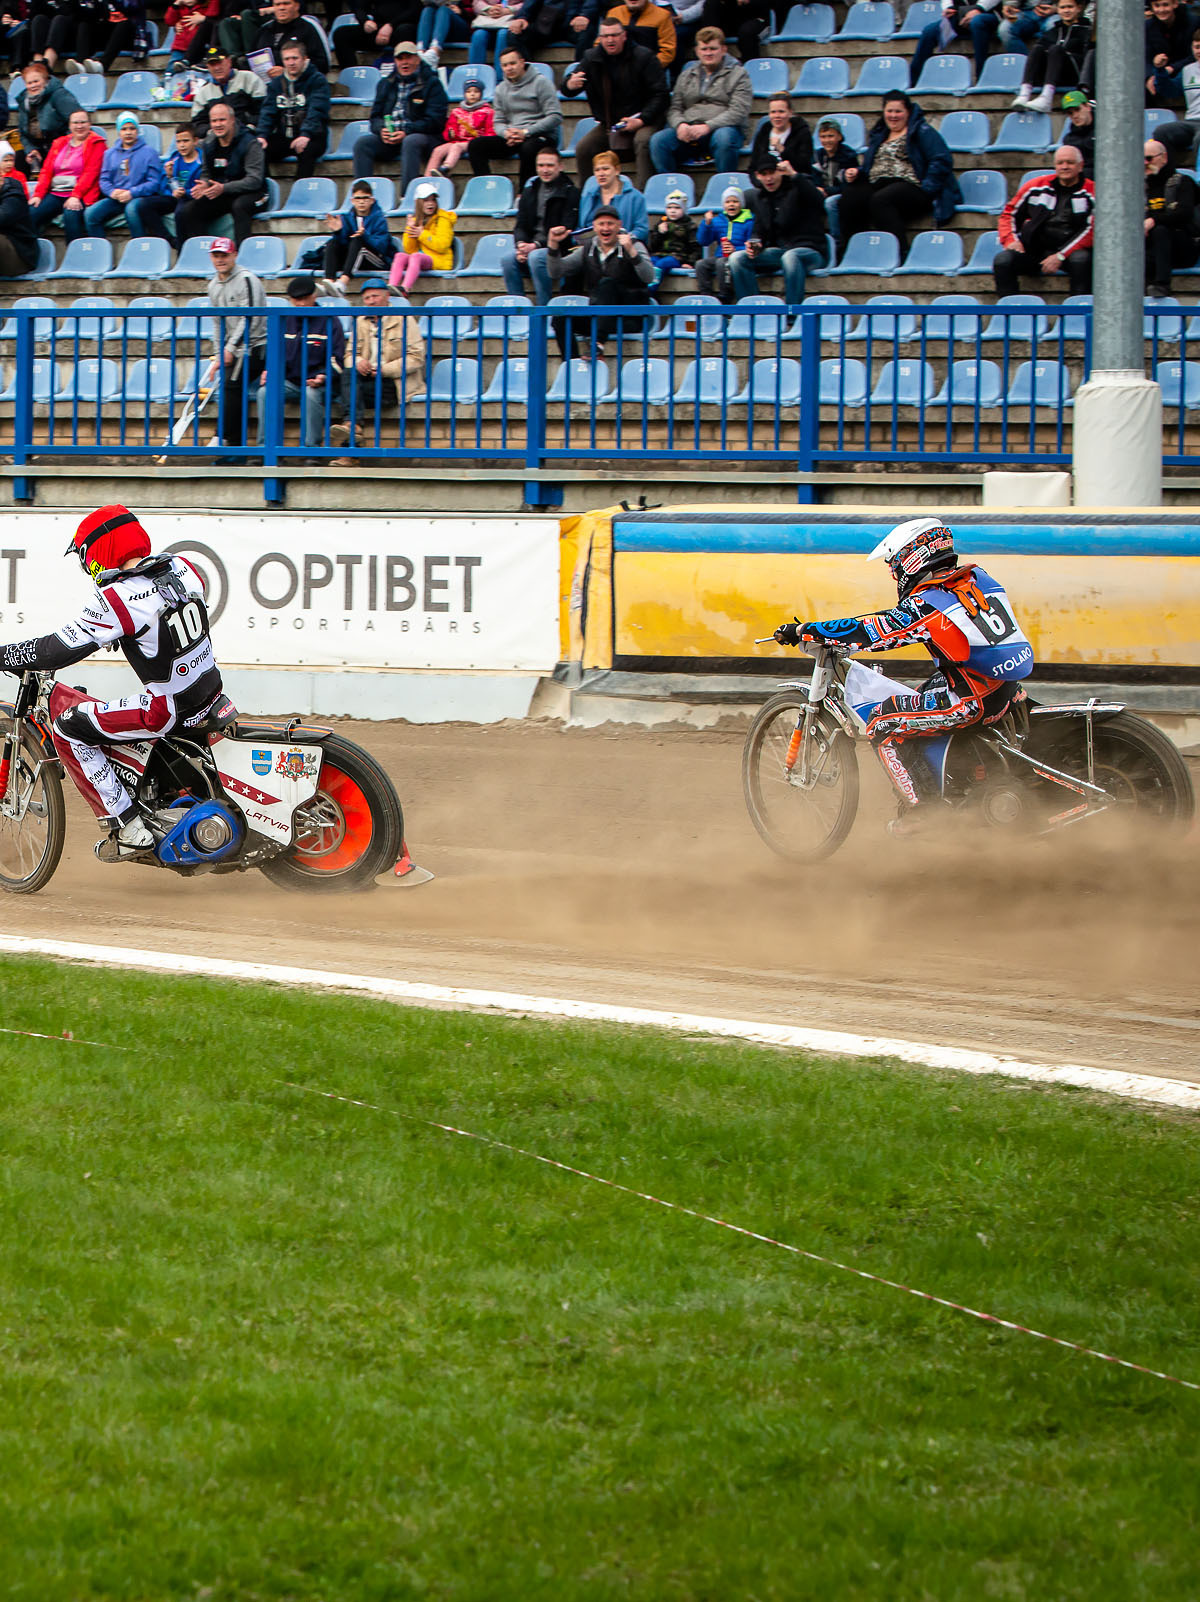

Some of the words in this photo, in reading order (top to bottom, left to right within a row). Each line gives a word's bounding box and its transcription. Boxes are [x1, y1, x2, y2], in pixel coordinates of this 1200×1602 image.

[249, 552, 482, 613] OPTIBET
[83, 606, 104, 621] PTIBET
[166, 601, 203, 649] 10
[247, 616, 376, 631] SPORTA
[401, 616, 482, 634] BĀRS
[981, 606, 1006, 636] 6
[189, 644, 212, 669] OPTIBET
[992, 646, 1033, 677] STOLARO
[245, 808, 291, 833] LATVIA
